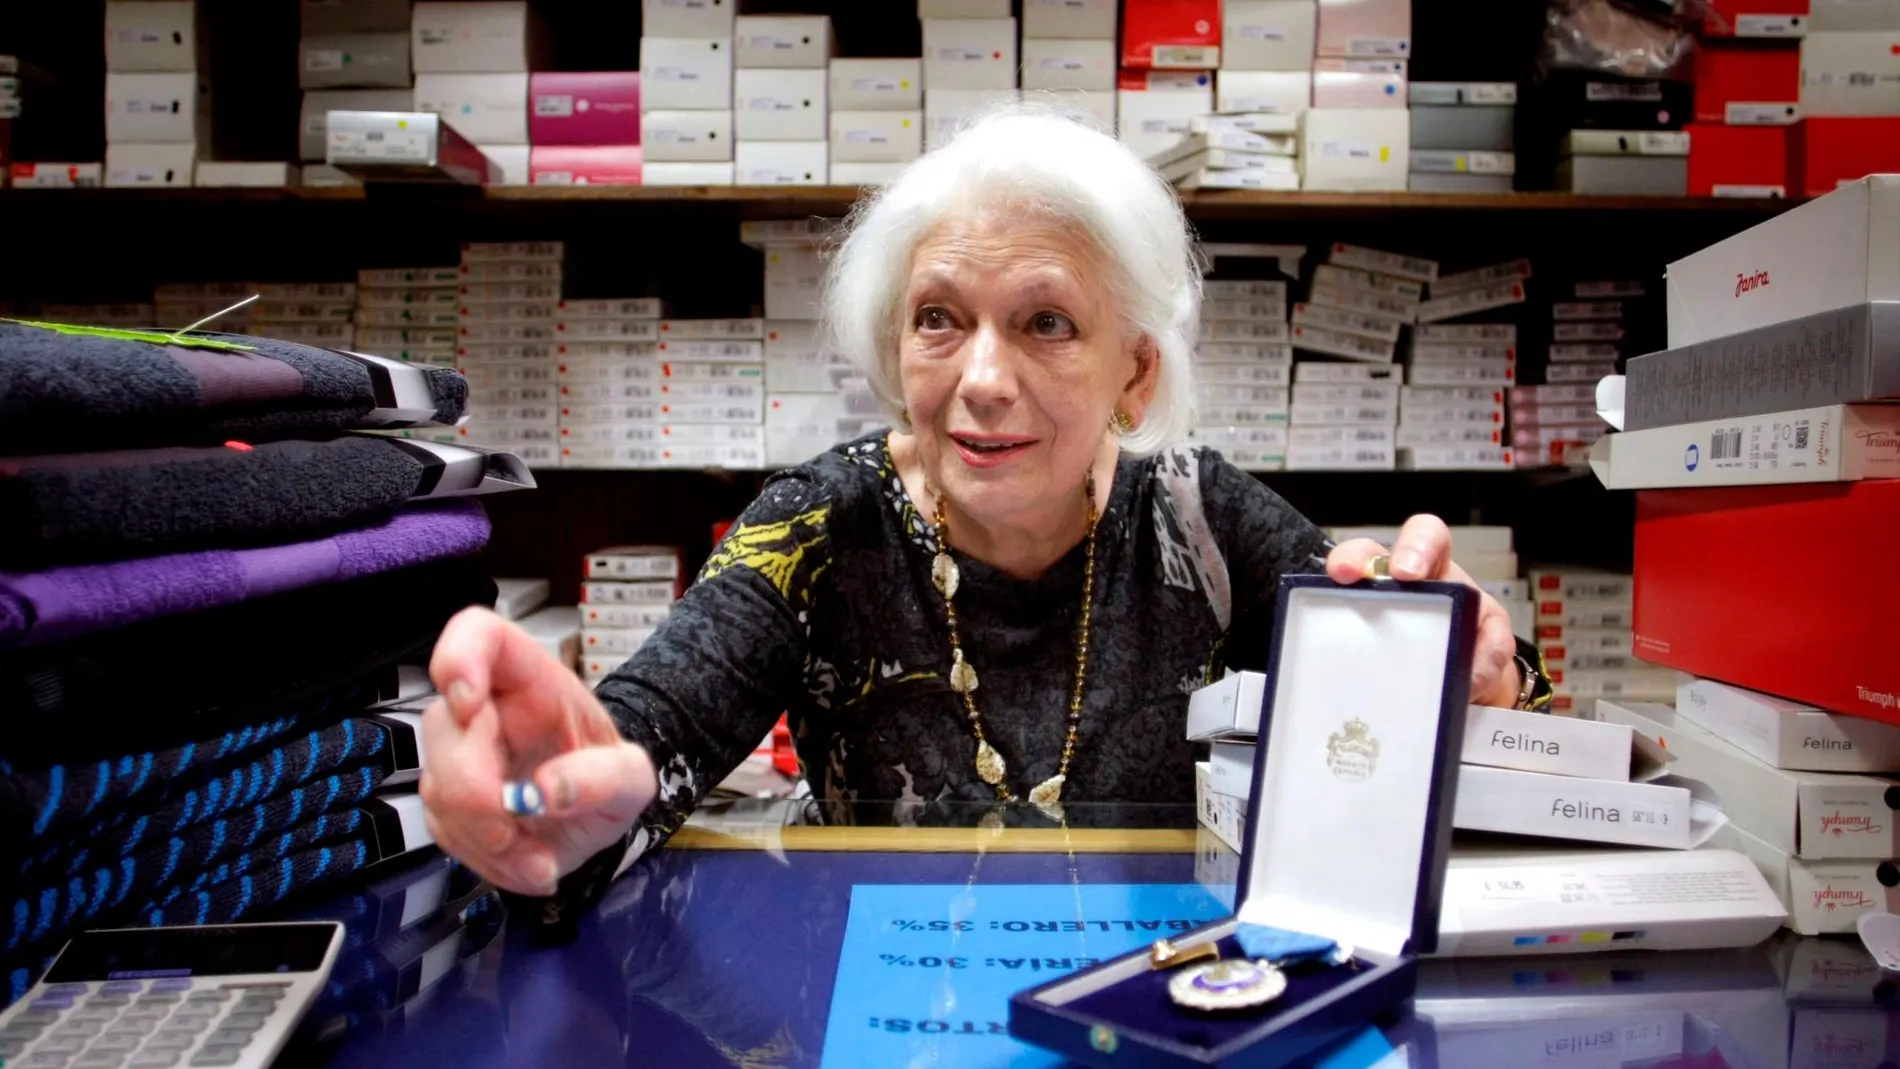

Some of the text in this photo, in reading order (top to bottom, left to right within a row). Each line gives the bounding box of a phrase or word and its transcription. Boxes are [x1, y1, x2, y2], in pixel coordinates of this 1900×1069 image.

[1735, 269, 1769, 298] Janira
[1856, 685, 1896, 709] Triumph
[1821, 810, 1882, 834] Triumph
[1812, 884, 1876, 909] Triumph
[892, 920, 975, 932] 35%
[879, 954, 968, 969] 30%
